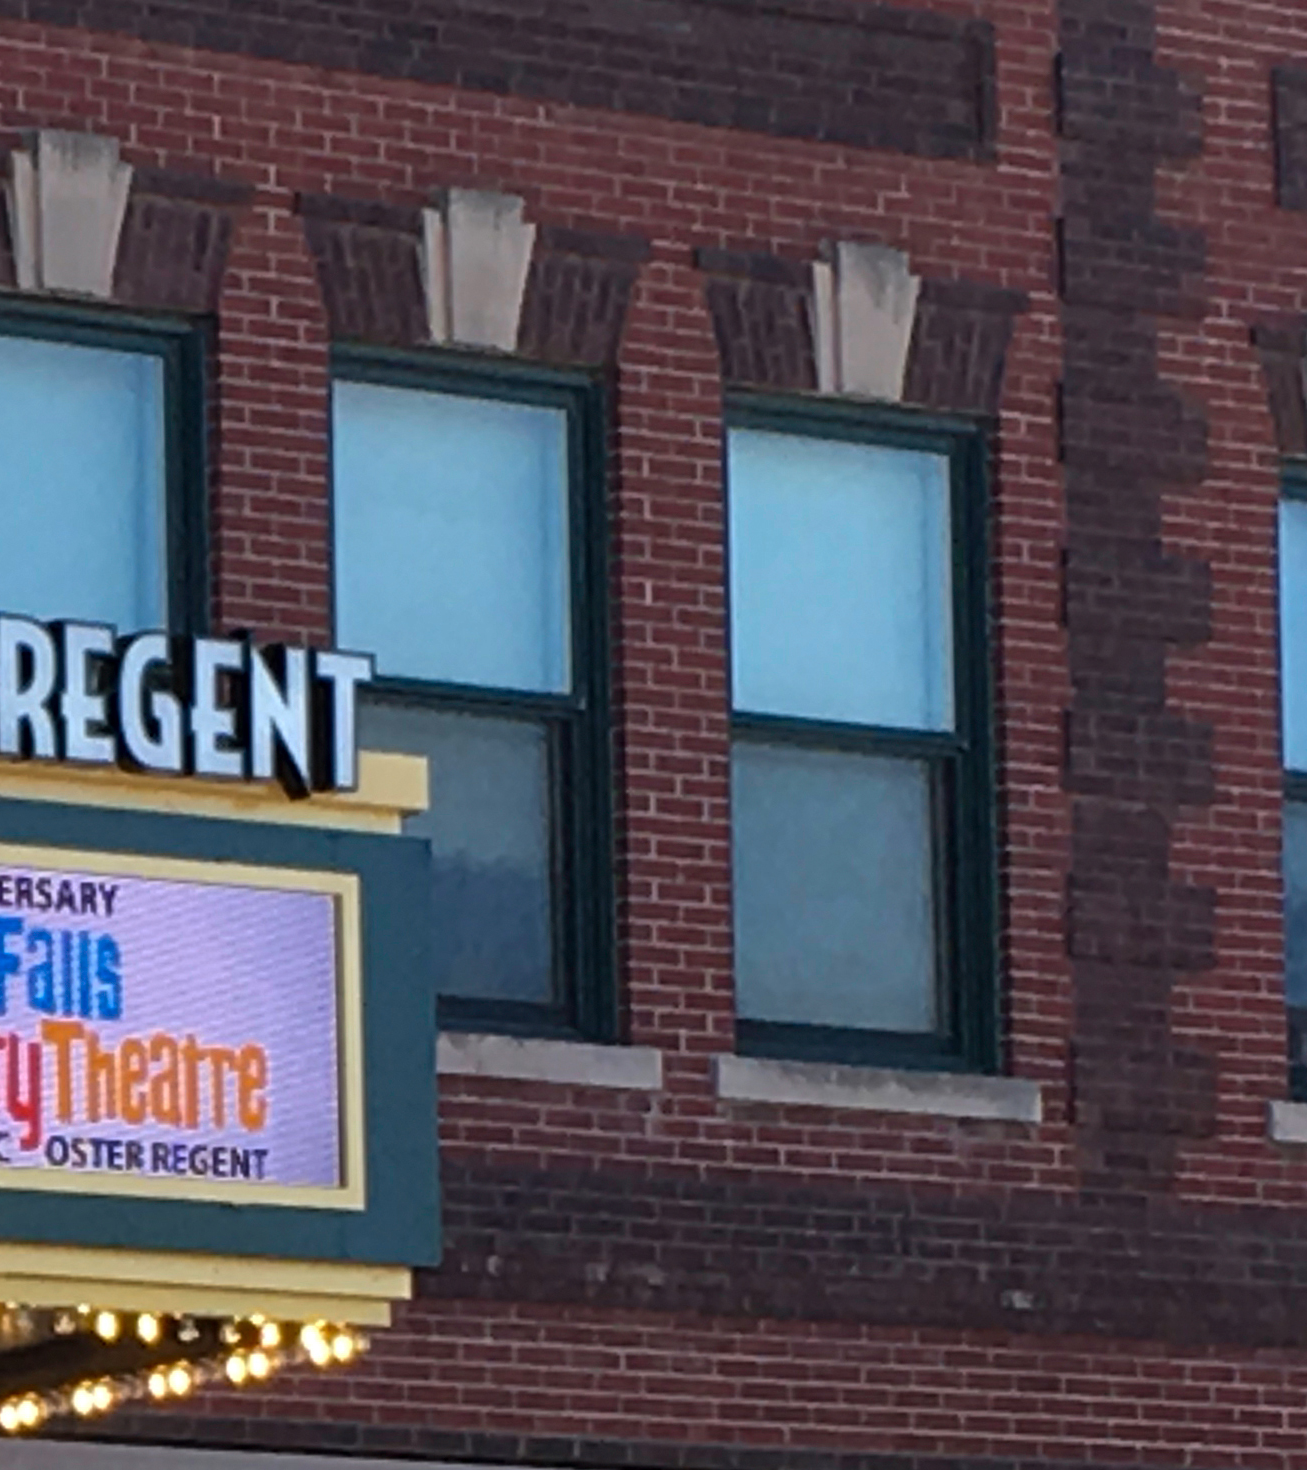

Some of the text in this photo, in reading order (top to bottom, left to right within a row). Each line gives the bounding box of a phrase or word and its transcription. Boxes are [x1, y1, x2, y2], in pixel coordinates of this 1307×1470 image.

[40, 1018, 270, 1133] Theatre
[44, 1134, 145, 1171] OSTER
[151, 1140, 270, 1180] REGENT
